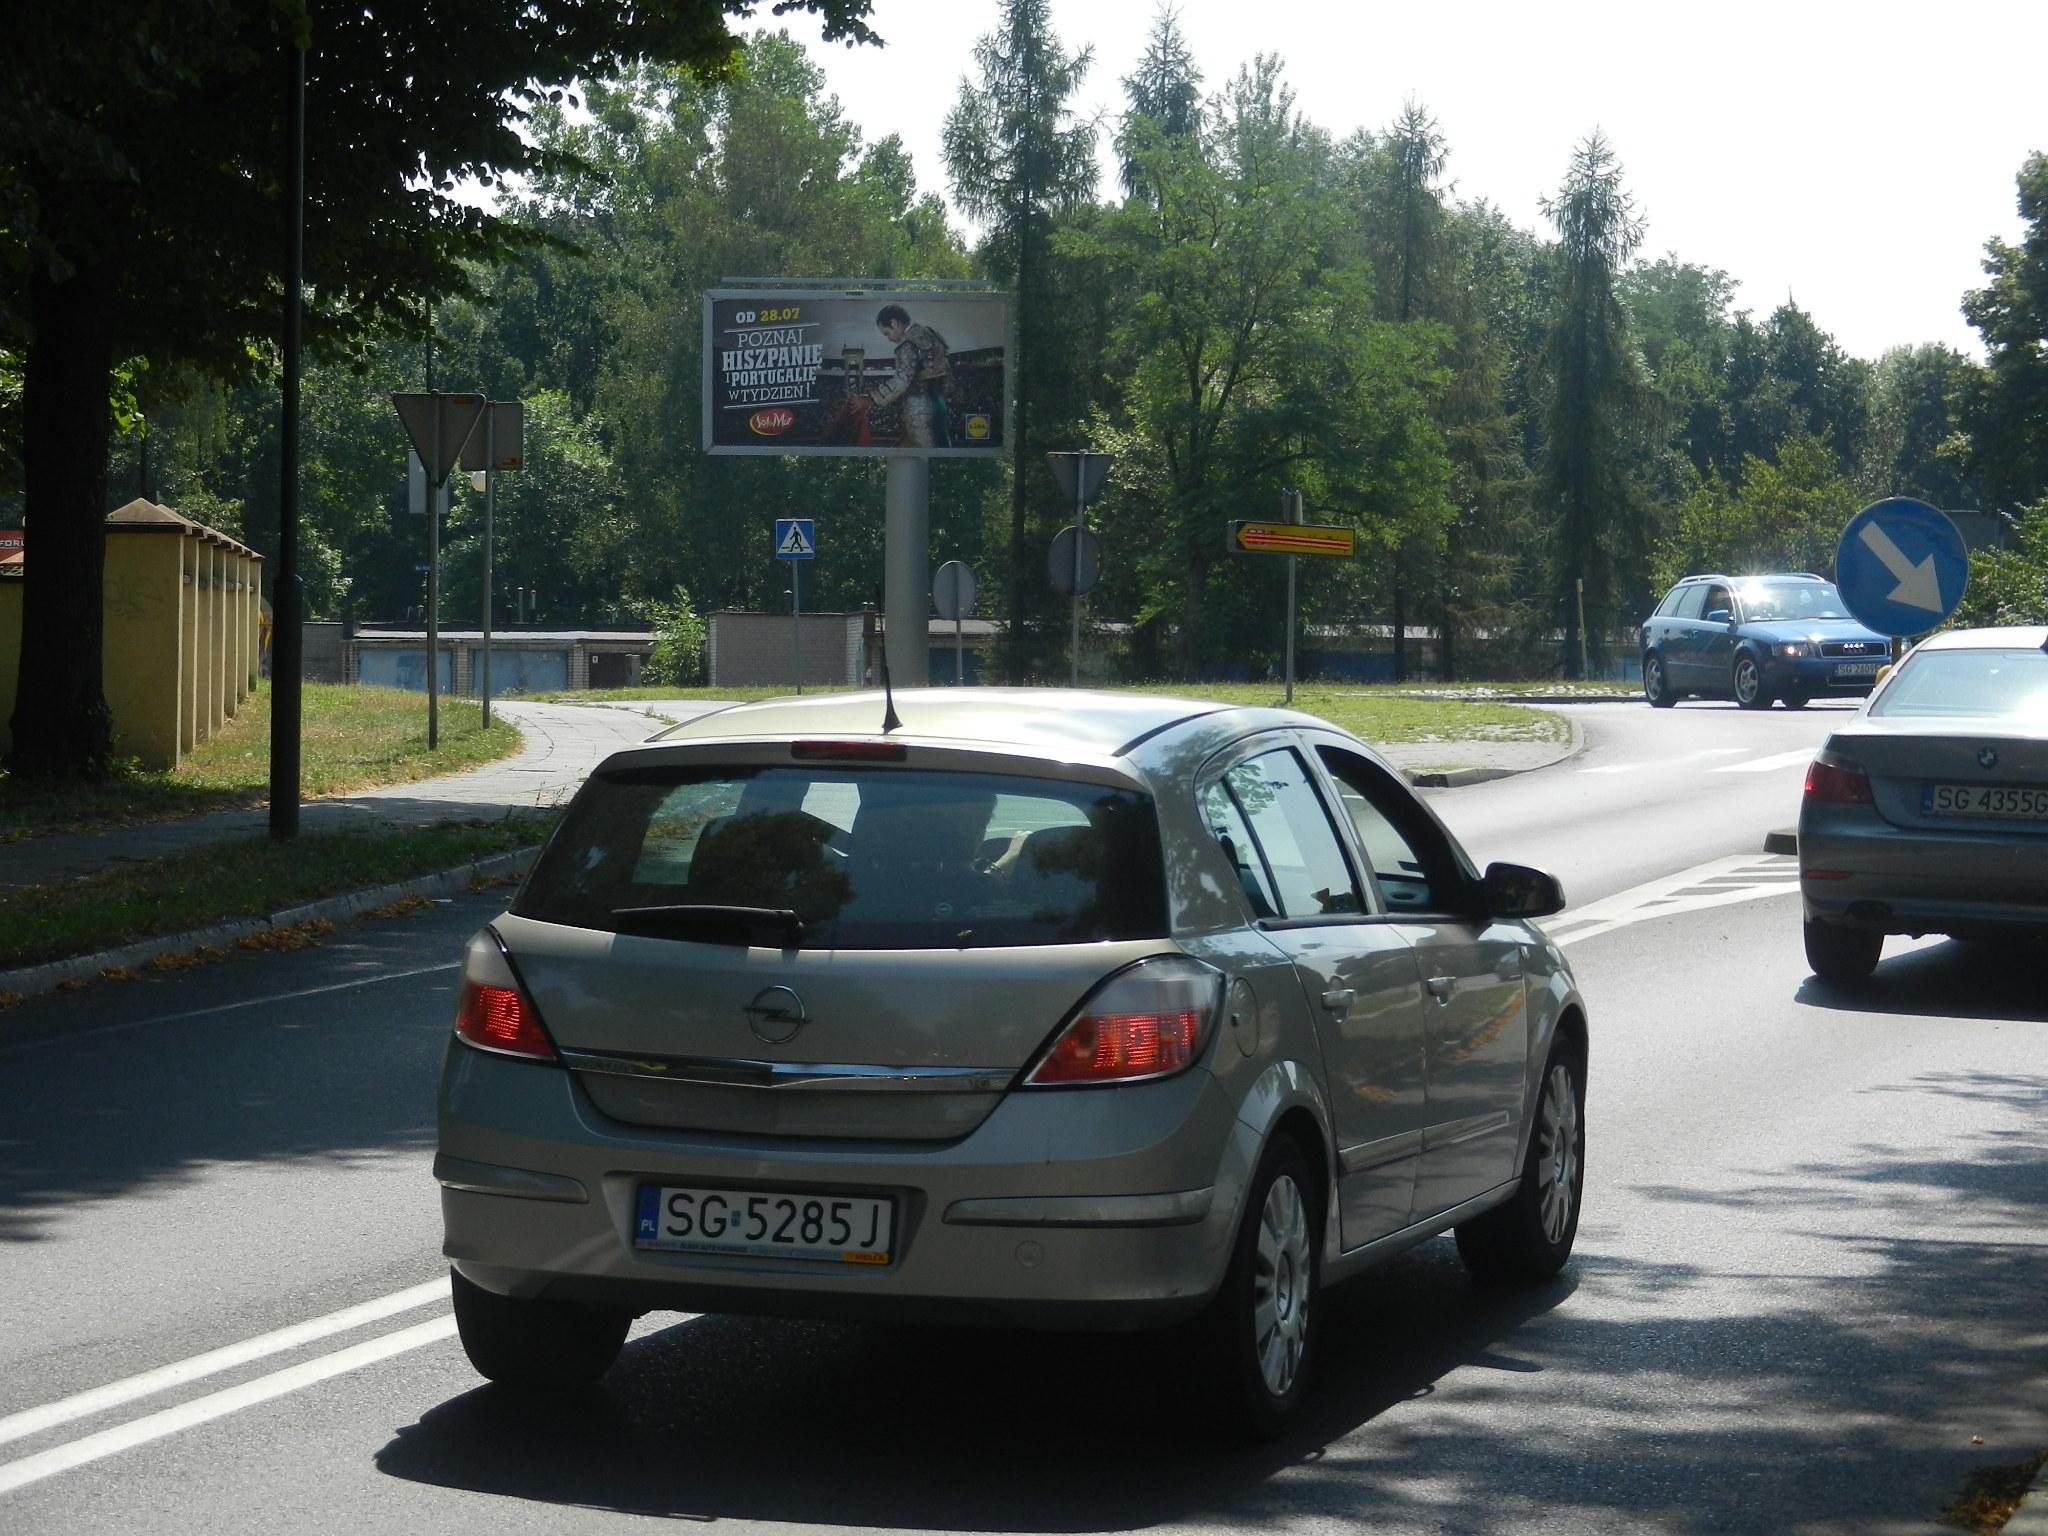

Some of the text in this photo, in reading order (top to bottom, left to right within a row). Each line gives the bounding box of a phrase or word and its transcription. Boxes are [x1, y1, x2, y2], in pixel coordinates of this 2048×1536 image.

[735, 307, 801, 324] OD 28.07
[737, 328, 804, 348] POZNAJ
[722, 344, 823, 371] HISZPANIĘ
[731, 366, 817, 387] PORTUGALIĘ
[1938, 787, 2048, 814] SG 4355G
[640, 1219, 656, 1232] PL
[666, 1192, 879, 1248] SG 5285J
